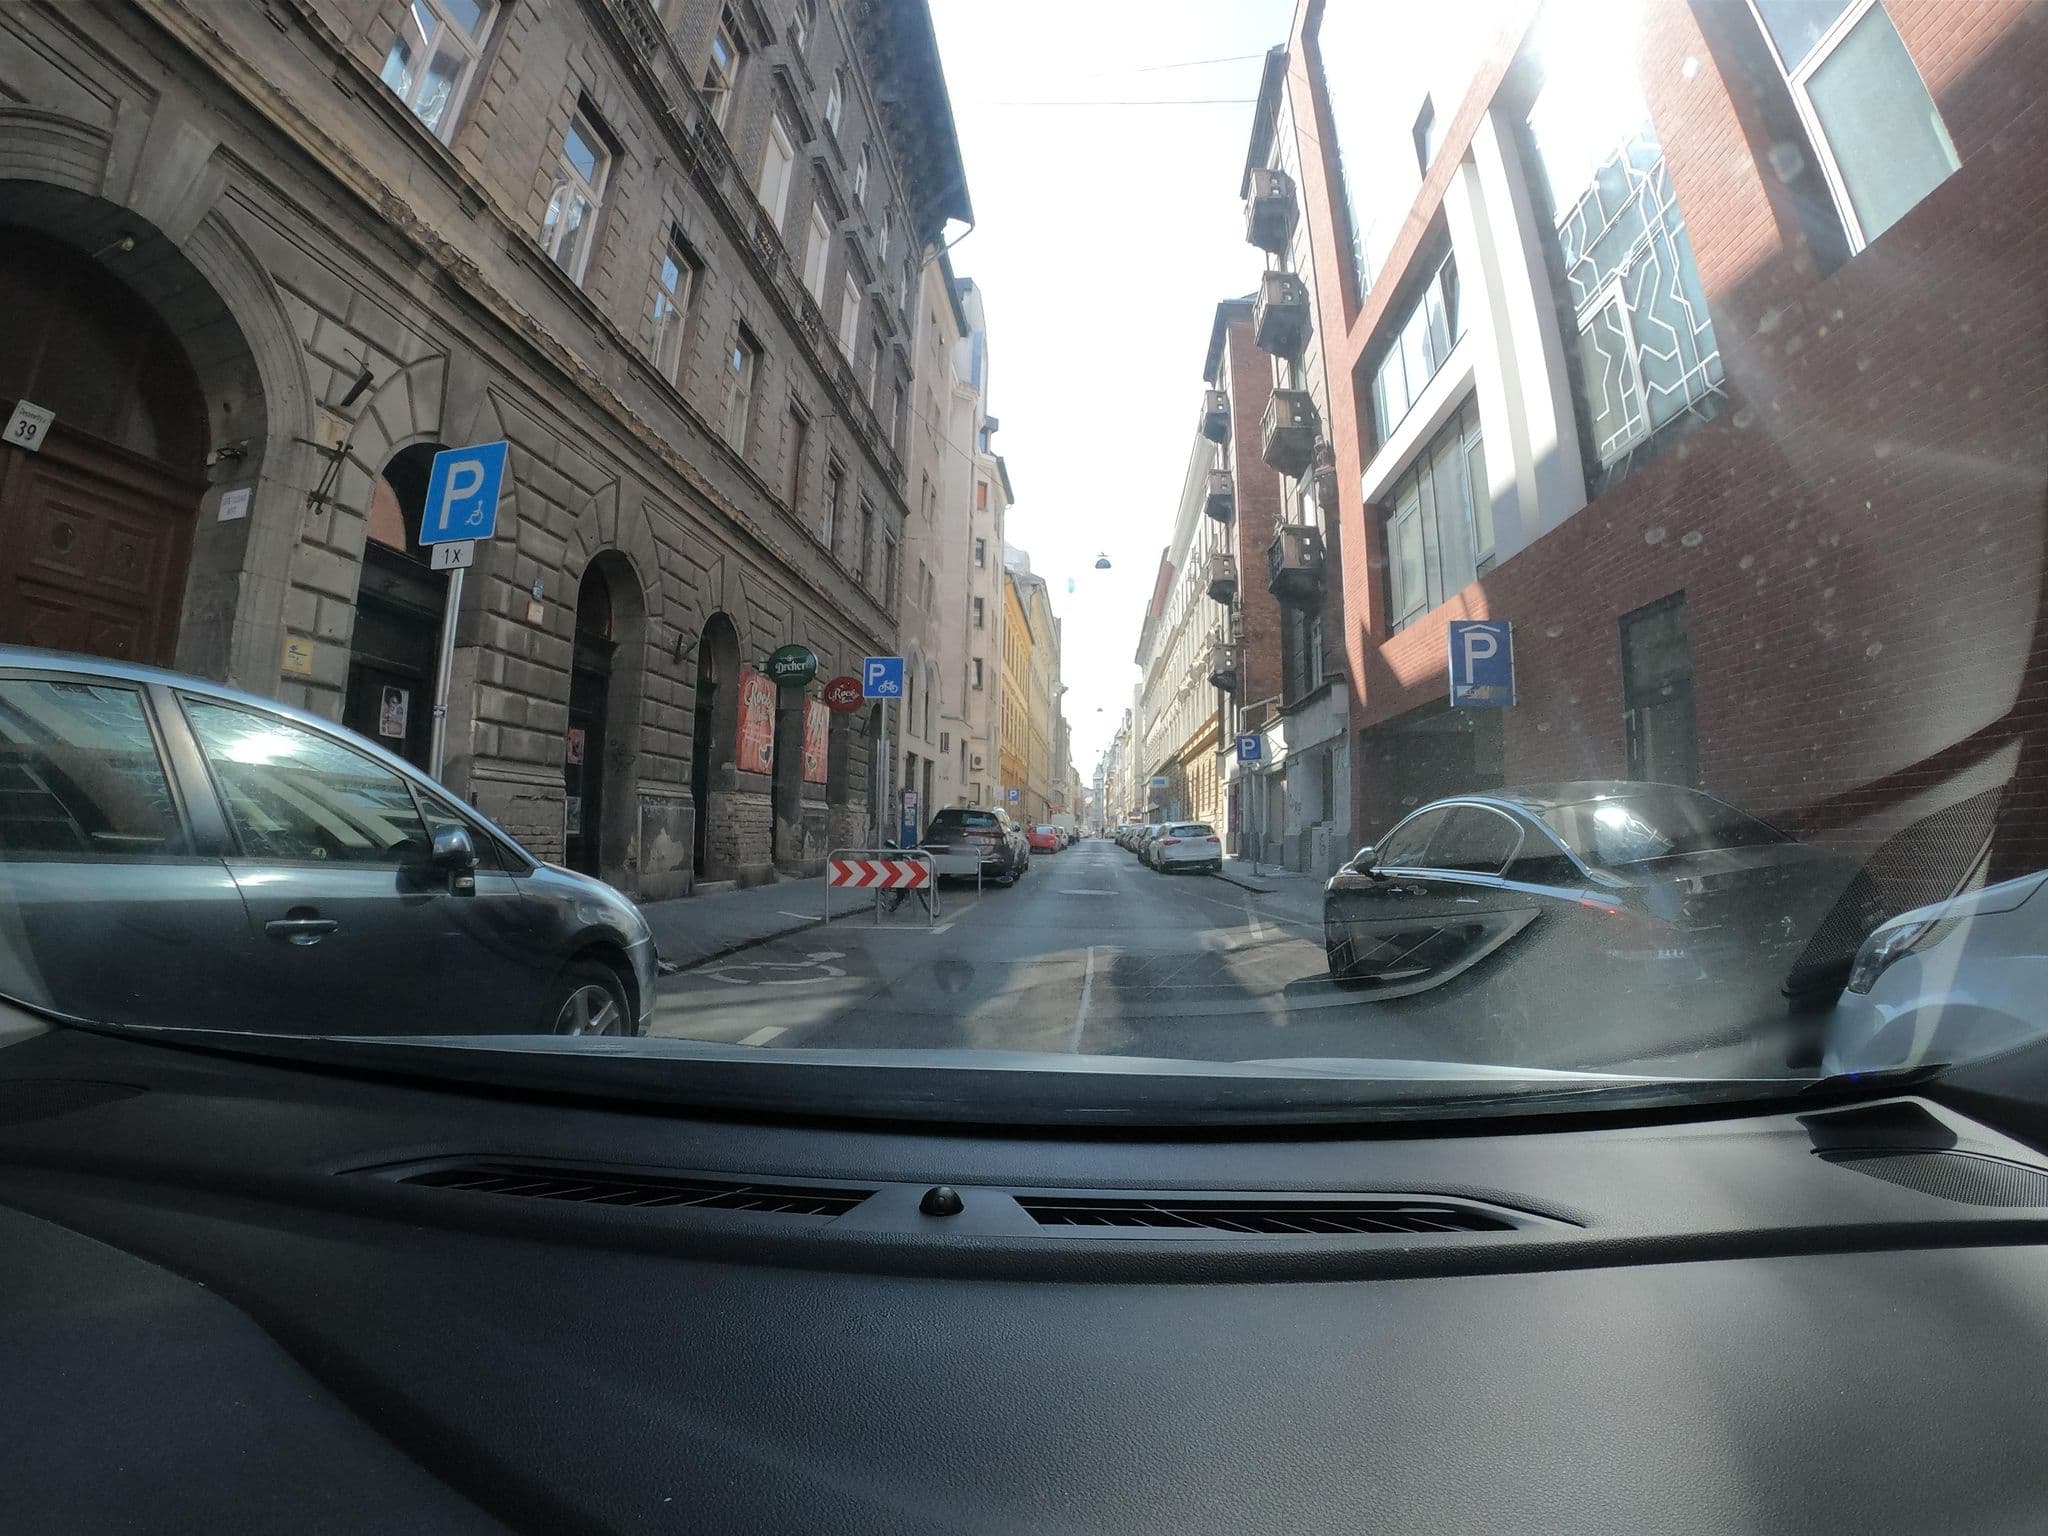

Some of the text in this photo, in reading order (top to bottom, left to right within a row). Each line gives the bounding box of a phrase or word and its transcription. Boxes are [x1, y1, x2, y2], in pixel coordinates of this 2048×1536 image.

[15, 420, 37, 440] 39
[439, 460, 484, 529] P
[775, 660, 806, 674] Dreher
[1464, 632, 1498, 684] P
[869, 663, 886, 686] P
[1241, 738, 1256, 758] P
[1010, 790, 1018, 800] P
